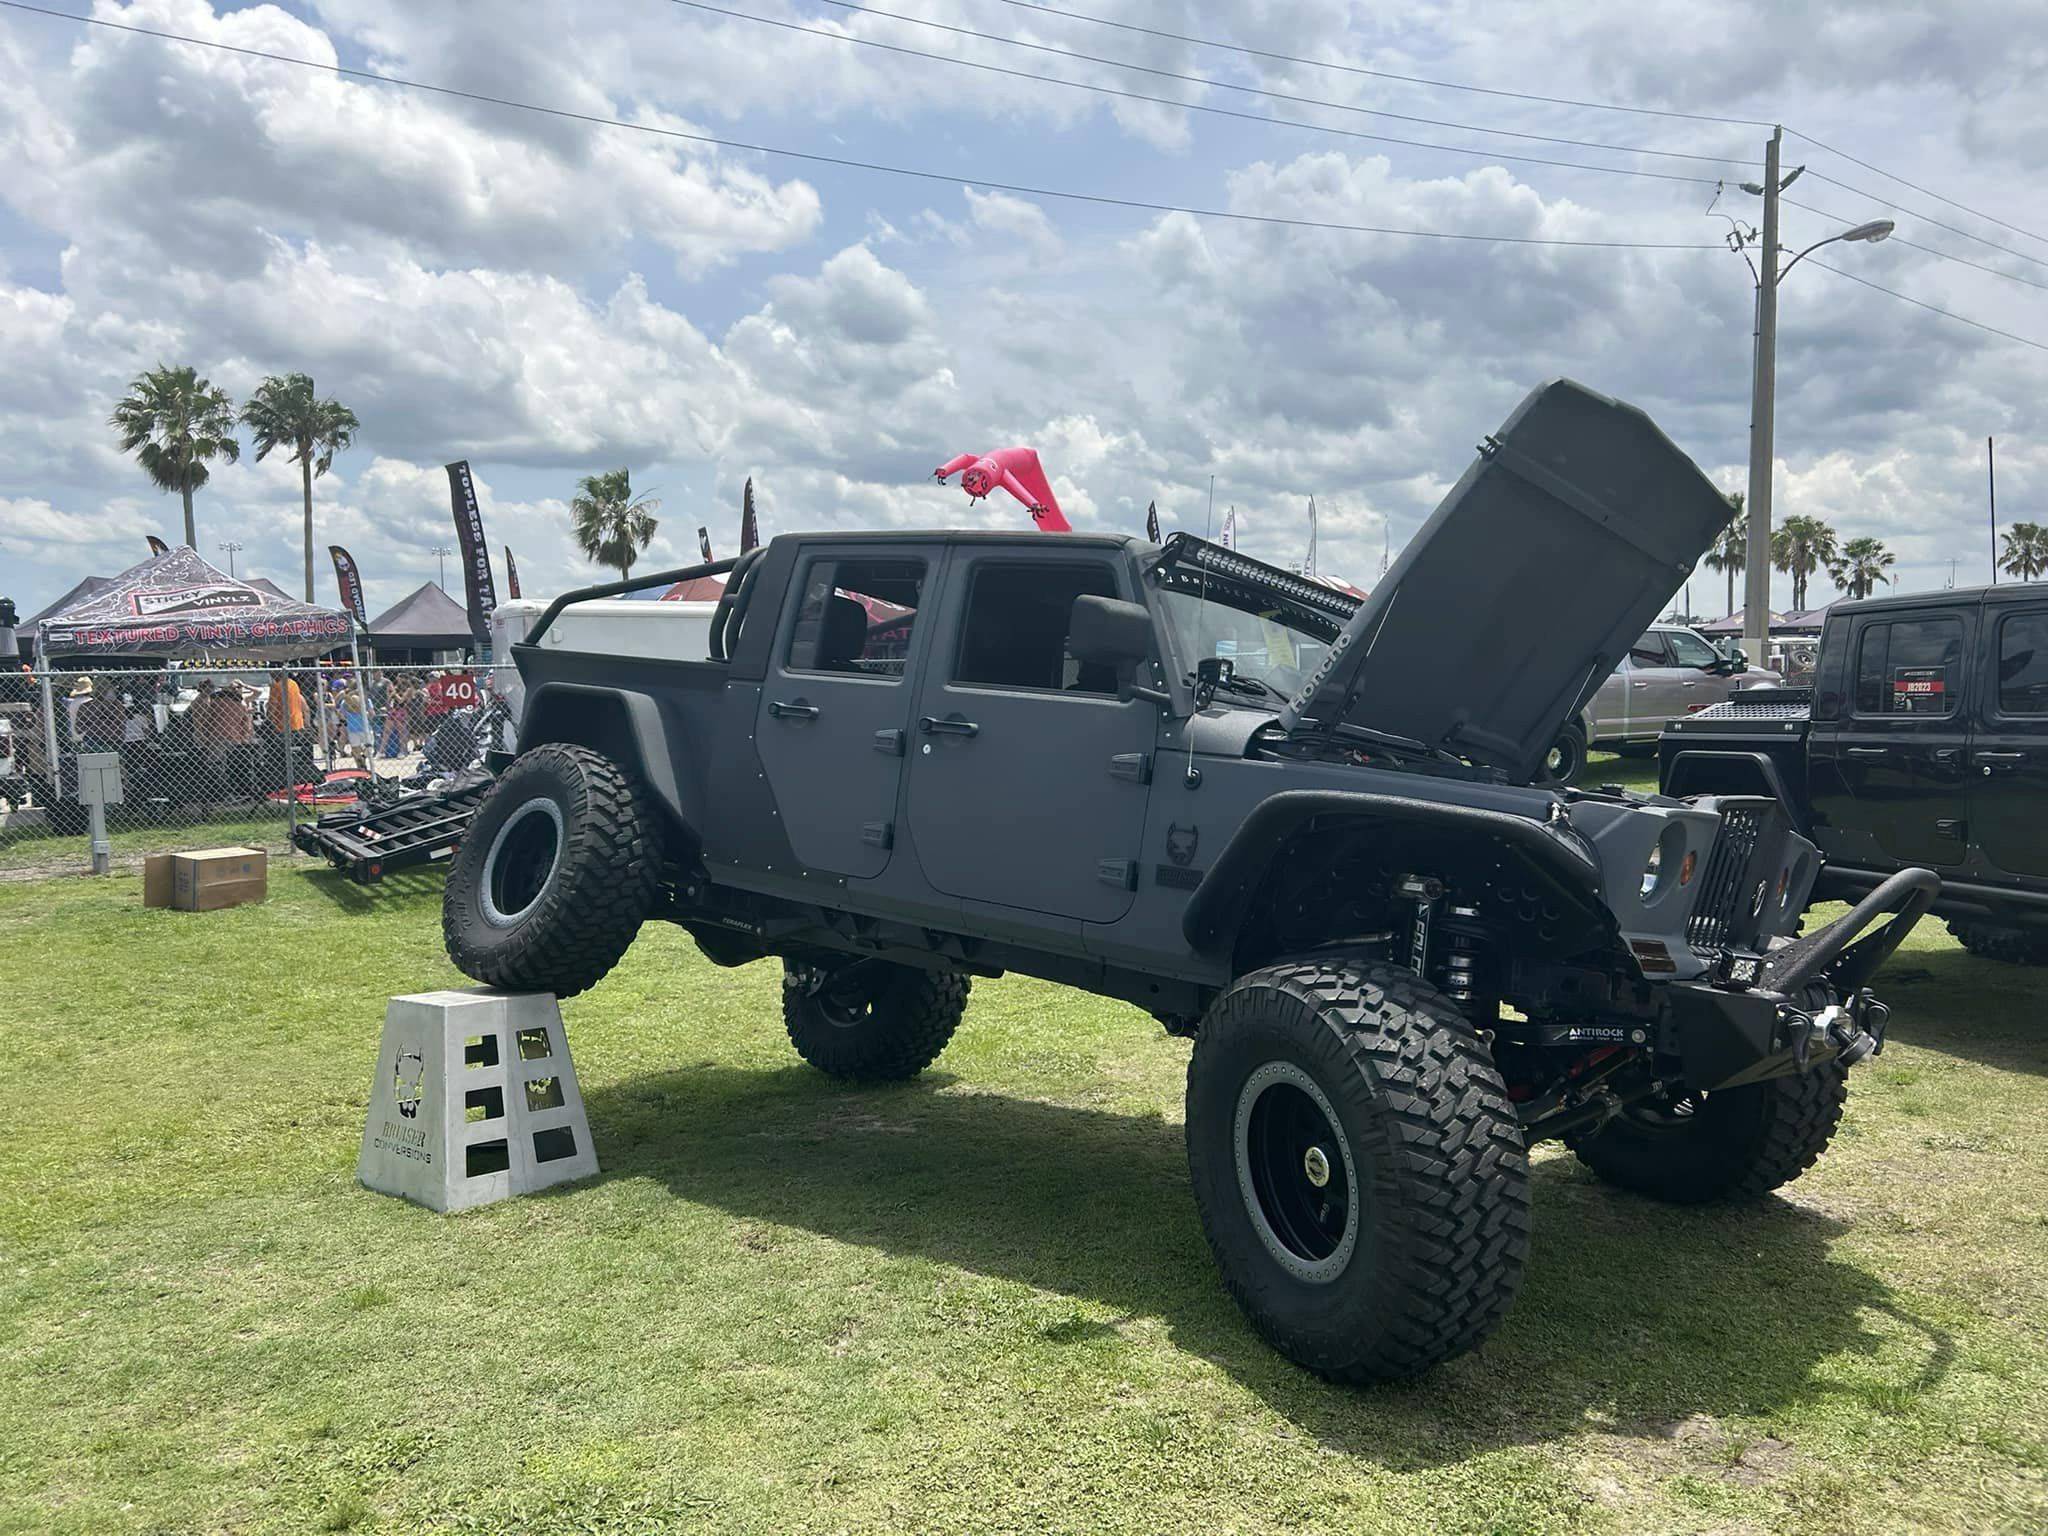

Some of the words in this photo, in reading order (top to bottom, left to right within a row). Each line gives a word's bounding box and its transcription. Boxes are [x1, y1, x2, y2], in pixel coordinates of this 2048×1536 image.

[458, 465, 482, 542] TOPLESS
[475, 547, 489, 580] FOR
[145, 591, 201, 605] STICKY
[193, 596, 250, 606] VINYLZ
[75, 628, 178, 645] TEXTURED
[185, 623, 245, 640] VINYL
[251, 618, 348, 638] GRAPHICS
[1289, 633, 1352, 714] Honcho
[446, 682, 472, 700] 40
[1569, 1027, 1624, 1038] ANTIROCK
[374, 1138, 432, 1164] CONVERSIONS
